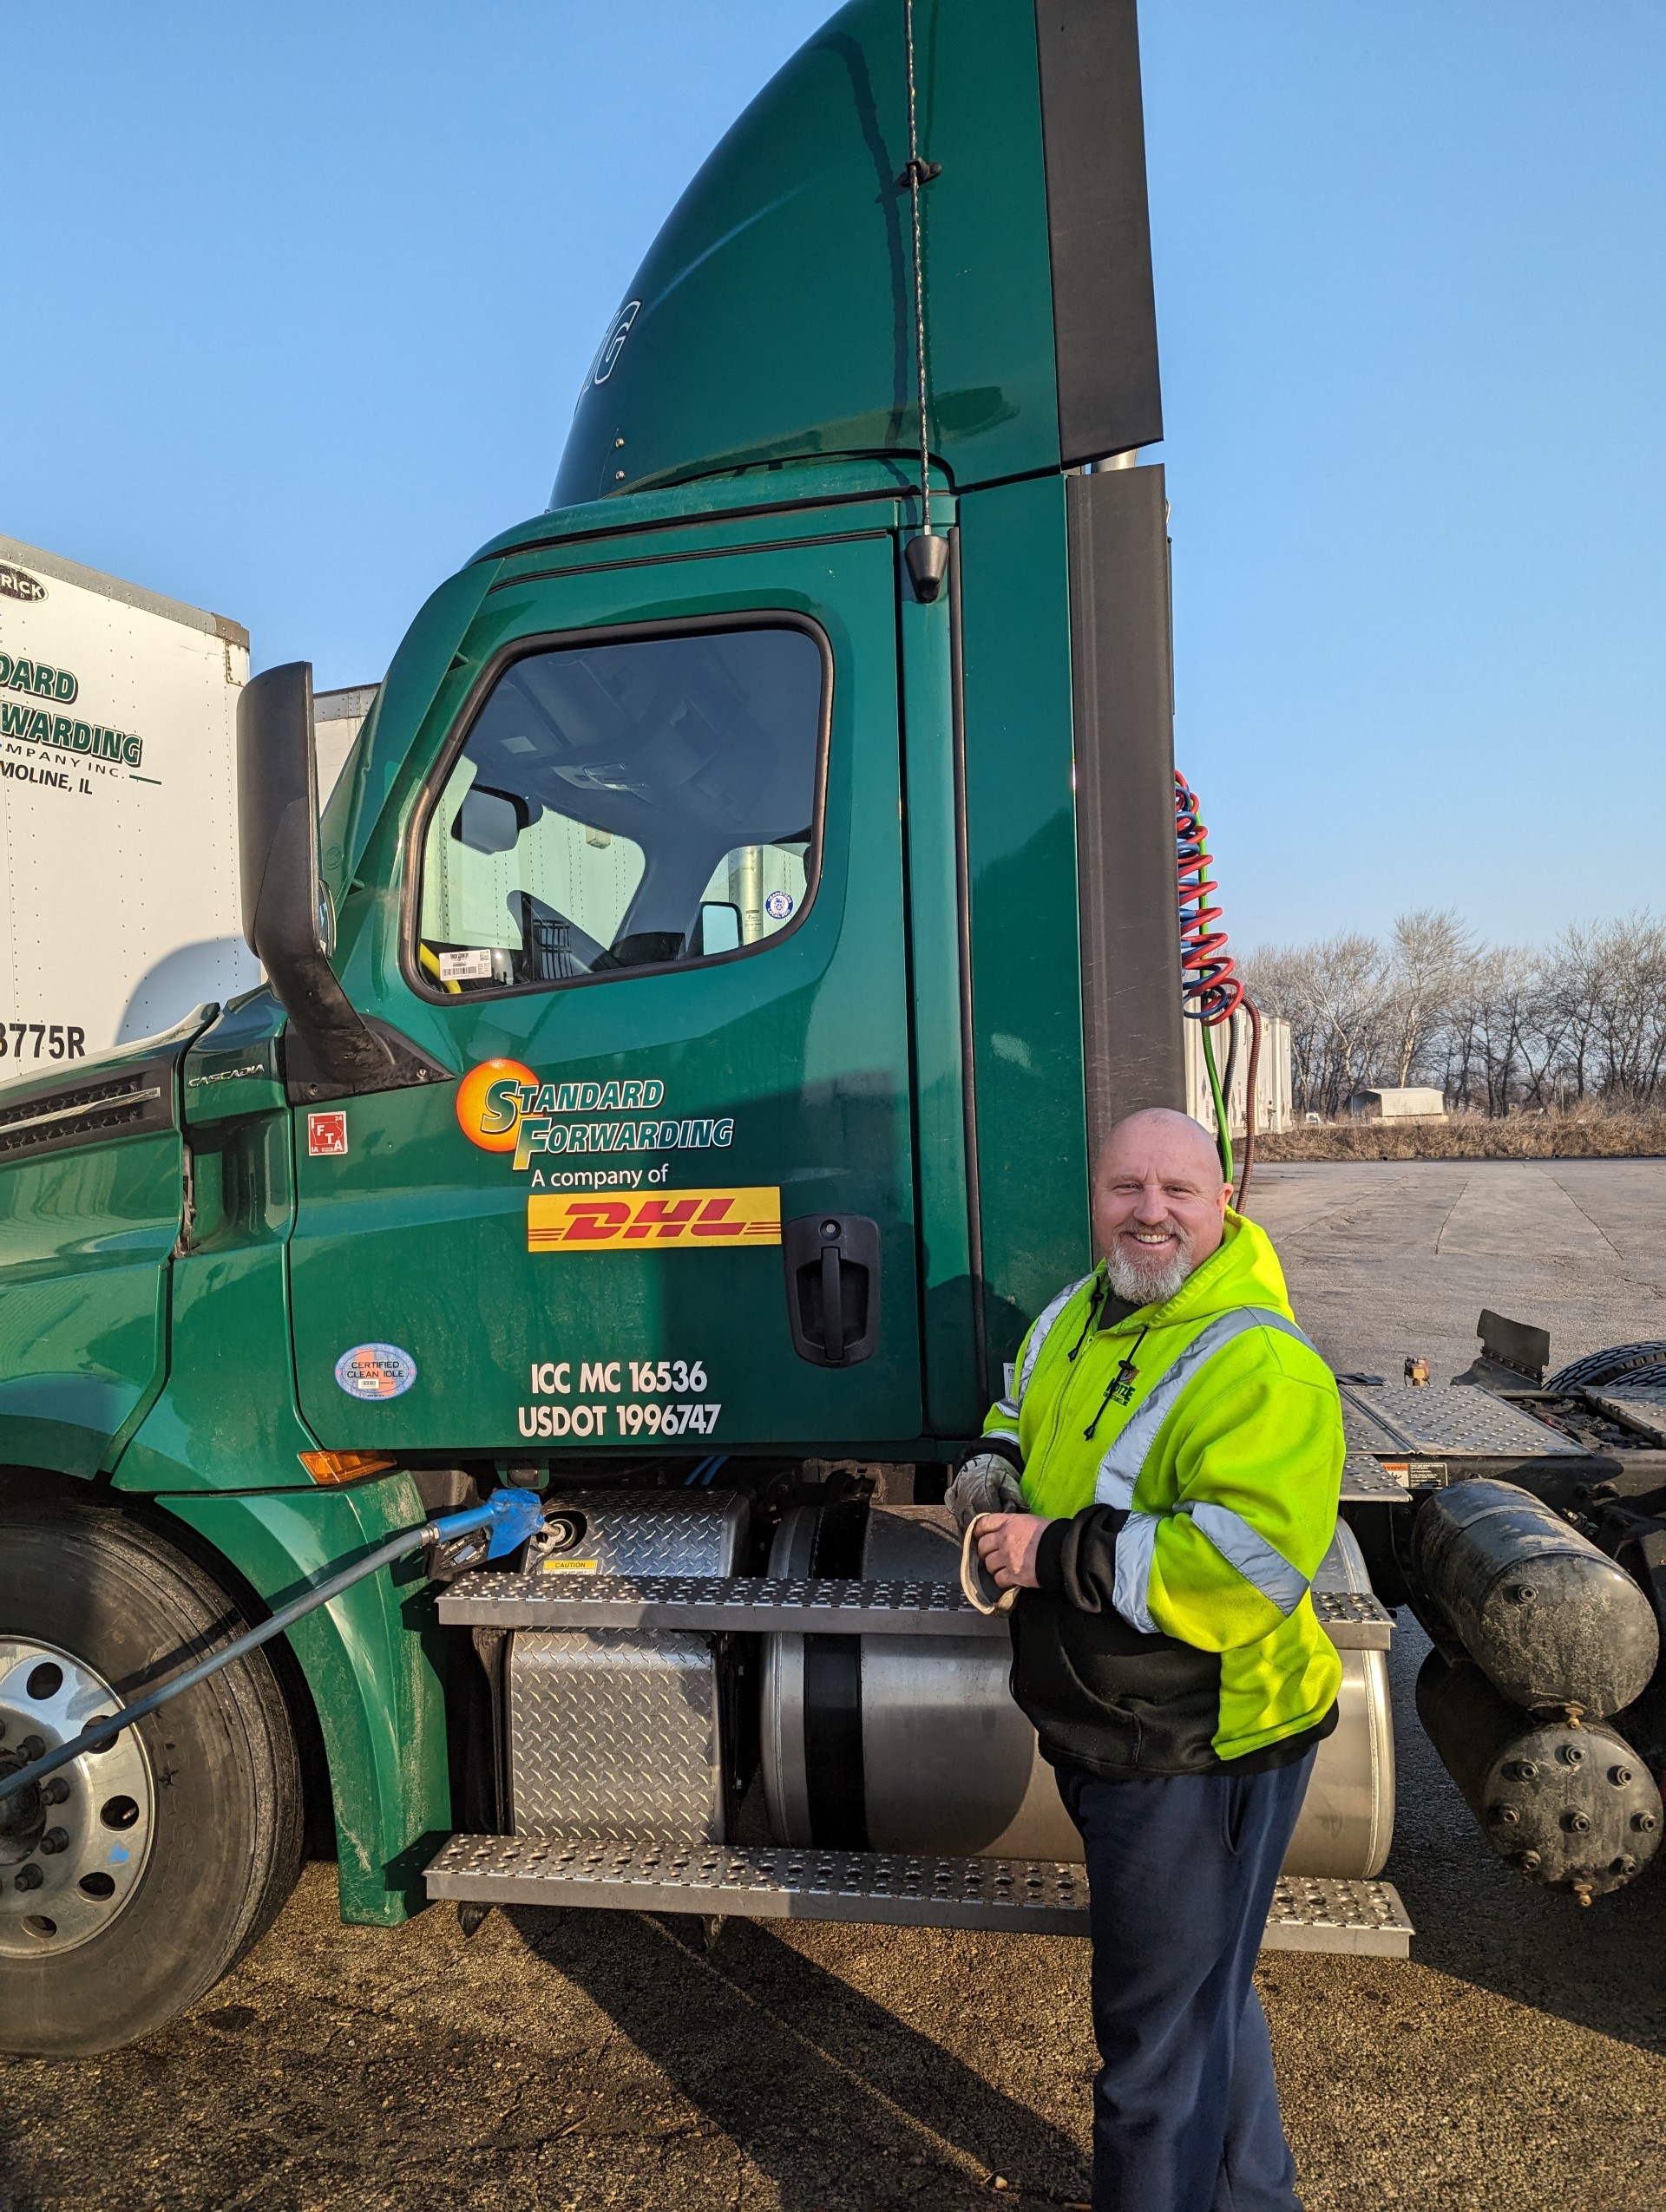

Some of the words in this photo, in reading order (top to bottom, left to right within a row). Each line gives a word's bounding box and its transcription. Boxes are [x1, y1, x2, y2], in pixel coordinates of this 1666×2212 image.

[1, 573, 43, 599] RICK
[0, 699, 142, 768] WARDING
[0, 742, 81, 768] MPANY
[88, 762, 125, 779] INC.
[0, 760, 73, 792] MOLINE,
[79, 777, 93, 795] IL
[768, 892, 791, 903] TEAMSTERS
[768, 907, 781, 919] LOCAL
[188, 1063, 265, 1087] CASCADIA
[480, 1078, 666, 1135] STANDARD
[511, 1116, 736, 1171] FORWARDING
[531, 1168, 546, 1188] A
[550, 1166, 643, 1189] company
[647, 1162, 670, 1183] of
[561, 1197, 745, 1241] DHL
[531, 1363, 571, 1394] ICC
[579, 1362, 621, 1393] MC
[628, 1360, 708, 1392] 16536
[518, 1404, 607, 1436] USDOT
[615, 1404, 722, 1436] 1996747
